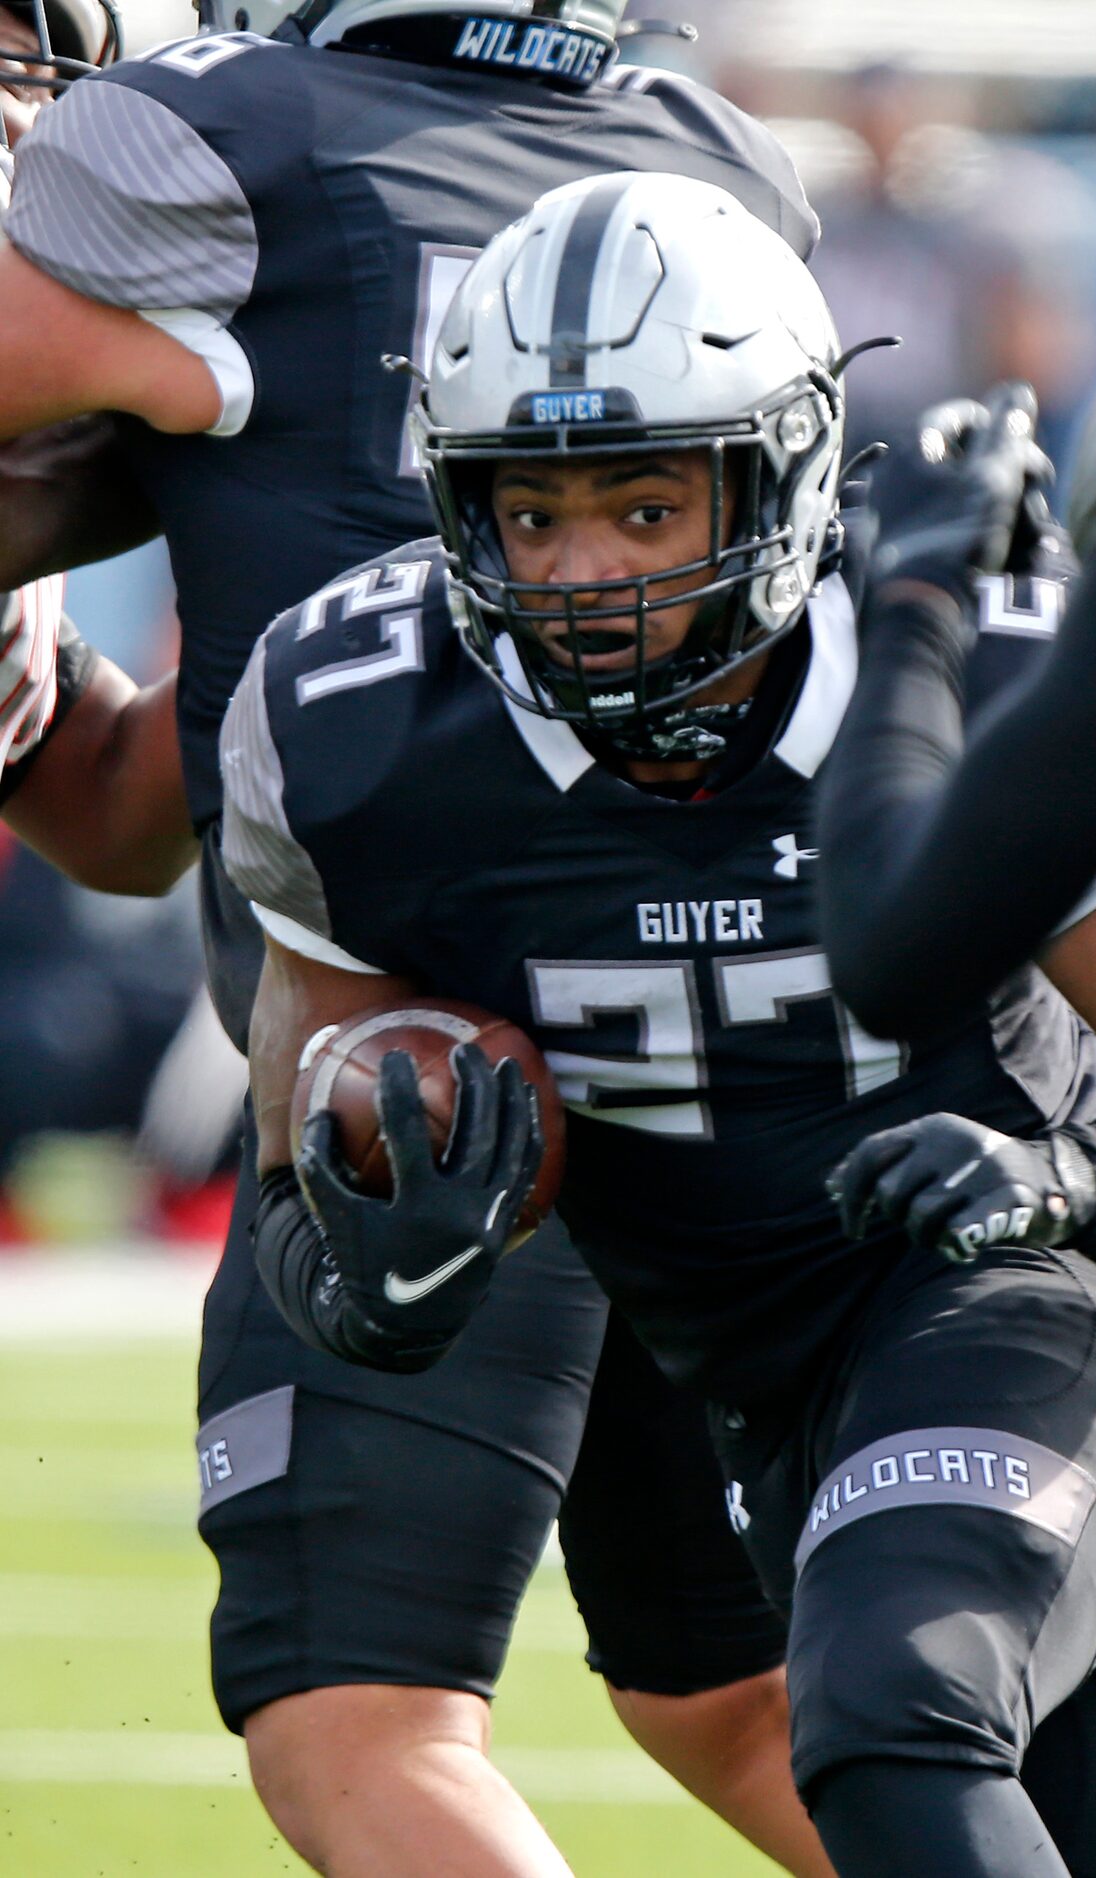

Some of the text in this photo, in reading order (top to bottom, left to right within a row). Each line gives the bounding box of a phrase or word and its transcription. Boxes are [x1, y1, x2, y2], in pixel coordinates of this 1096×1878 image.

[453, 18, 607, 81] WILDCATS
[533, 395, 603, 423] GUYER
[294, 560, 433, 707] 27
[589, 691, 635, 707] iddell
[637, 898, 764, 943] GUYER
[525, 944, 911, 1142] 27
[810, 1447, 1032, 1534] WILDCATS
